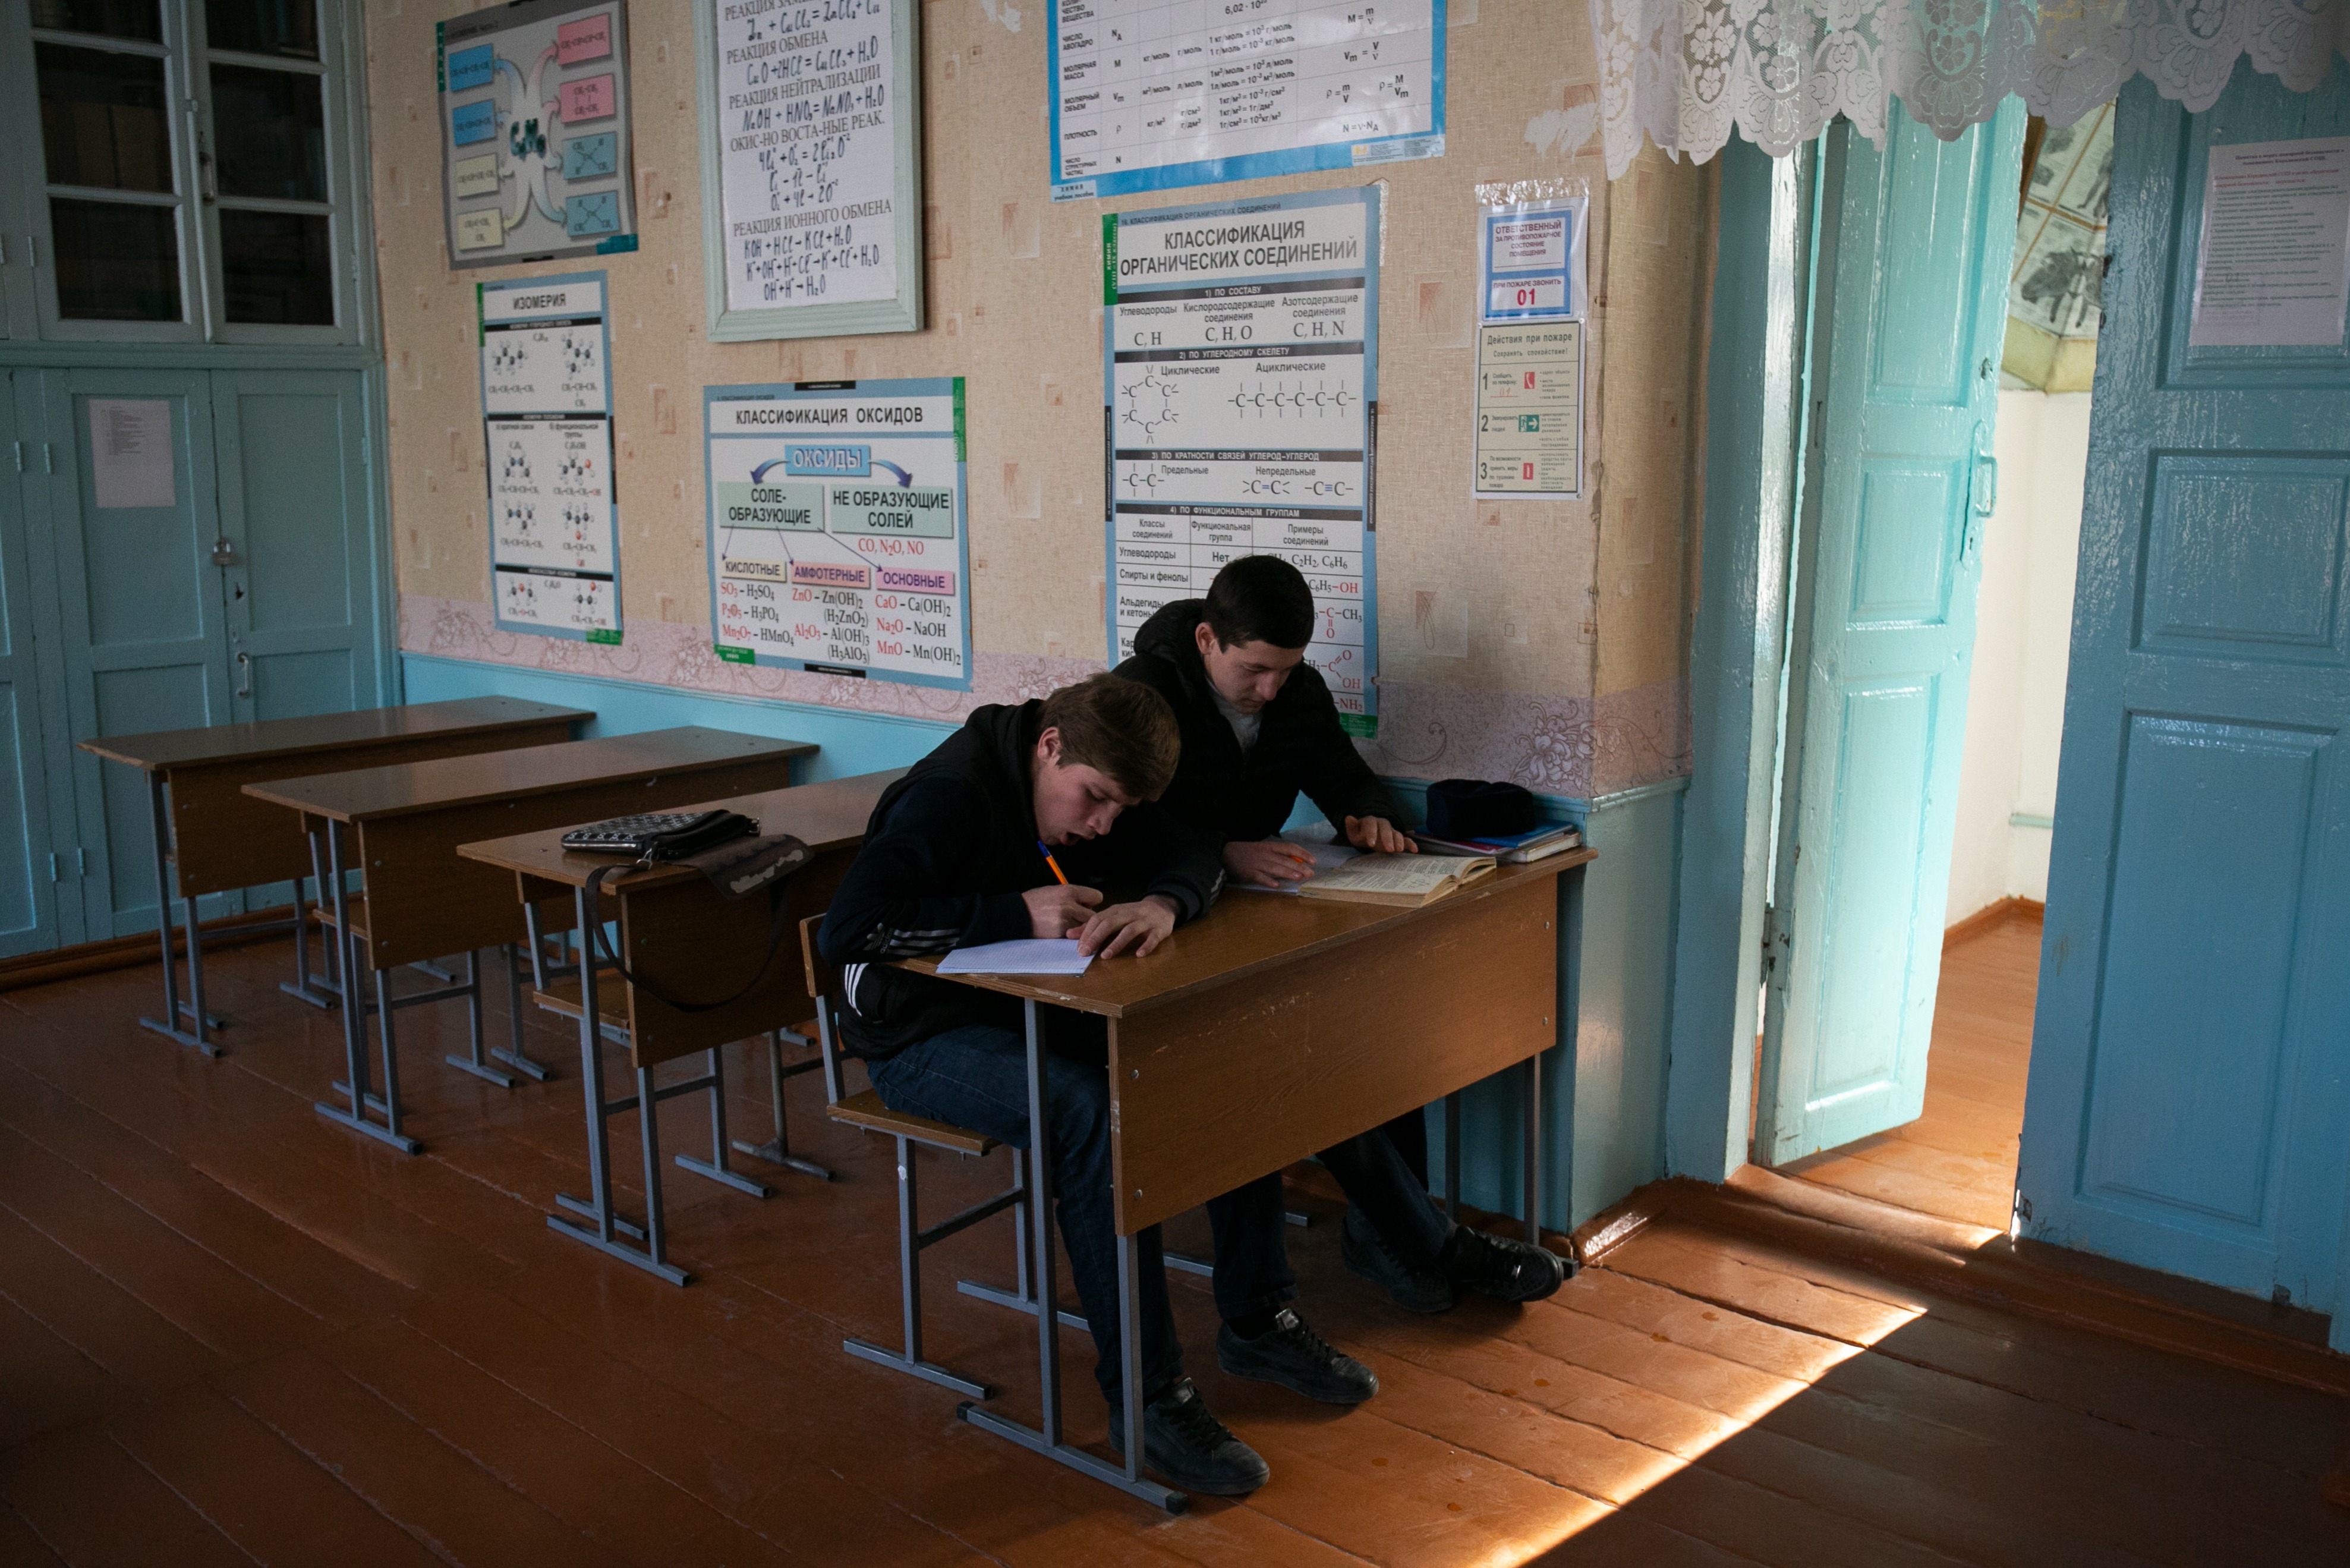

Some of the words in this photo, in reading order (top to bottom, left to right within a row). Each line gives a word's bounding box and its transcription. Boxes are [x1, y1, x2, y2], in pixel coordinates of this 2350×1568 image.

[1225, 3, 1243, 15] 6,02
[727, 40, 776, 64] РЕАКЦИЯ
[779, 30, 828, 52] ОБМЕНА
[729, 87, 779, 109] РЕАКЦИЯ
[781, 64, 881, 99] НЕЙТРАЛИЗАЦИИ
[730, 131, 779, 152] ОКИС-НО
[782, 118, 849, 143] ВОСТА-НЫЕ
[1064, 129, 1098, 140] ПЛОТНОСТЬ
[733, 220, 781, 237] РЕАКЦИЯ
[785, 207, 839, 231] ИОННОГО
[842, 199, 892, 220] ОБМЕНА
[1495, 220, 1561, 234] ОТВЕТСТВЕННЫЙ
[1164, 220, 1305, 250] КЛАССИФИКАЦИЯ
[1511, 241, 1545, 249] СОСТОЯНИЕ
[1120, 250, 1240, 276] ОРГАНИЧЕСКИХ
[1244, 235, 1357, 267] СОЕДИНЕНИЙ
[1509, 249, 1546, 257] ПОМЕЩЕНИЯ
[1215, 288, 1226, 297] ПО
[1228, 285, 1261, 295] СОСТАВУ
[1517, 288, 1536, 306] 01
[513, 294, 566, 310] ИЗОМЕРИЯ
[1183, 298, 1275, 314] Кислородсодержащие
[1281, 294, 1359, 308] Азотсодержащие
[1120, 305, 1177, 317] Углеводороды
[1204, 311, 1253, 322] соединения
[1293, 307, 1346, 319] соединения
[1487, 335, 1523, 345] Действия
[1526, 334, 1541, 344] при
[1543, 333, 1572, 343] пожаре
[1189, 350, 1199, 358] ПО
[1202, 348, 1255, 358] УГЛЕРОДНОМУ
[1257, 347, 1290, 357] СКЕЛЕТУ
[1161, 365, 1220, 376] Циклические
[1255, 362, 1326, 374] Ациклические
[1482, 373, 1488, 391] 1
[736, 408, 848, 426] КЛАССИФИКАЦИЯ
[856, 407, 923, 425] ОКСИДОВ
[1481, 414, 1489, 432] 2
[792, 448, 862, 471] ОКСИДЫ
[1218, 451, 1246, 460] СВЯЗЕЙ
[1161, 467, 1209, 476] Предельные
[1255, 467, 1316, 476] Непредельные
[1480, 462, 1487, 480] 3
[751, 488, 787, 503] СОЛЕ-
[833, 491, 850, 506] НЕ
[853, 492, 950, 512] ОБРАЗУЮЩИЕ
[729, 507, 811, 525] ОБРАЗУЮЩИЕ
[1193, 506, 1262, 517] ФУНКЦИОНАЛЬНЫМ
[1266, 508, 1300, 517] ГРУППАМ
[868, 510, 913, 528] СОЛЕЙ
[1139, 519, 1165, 529] Классы
[1191, 521, 1251, 532] Функциональная
[1288, 524, 1324, 535] Примеры
[1132, 529, 1173, 539] соединений
[1209, 534, 1233, 543] группа
[1283, 536, 1329, 546] соединений
[1119, 546, 1176, 561] Углеводороды
[1212, 552, 1230, 563] Нет
[725, 561, 780, 576] КИСЛОТНЫЕ
[794, 566, 864, 583] АМФОТЕРНЫЕ
[883, 572, 946, 588] ОСНОВНЫЕ
[1120, 569, 1148, 581] Спирты
[1157, 572, 1188, 583] фенолы
[1120, 596, 1164, 609] Альдегиды
